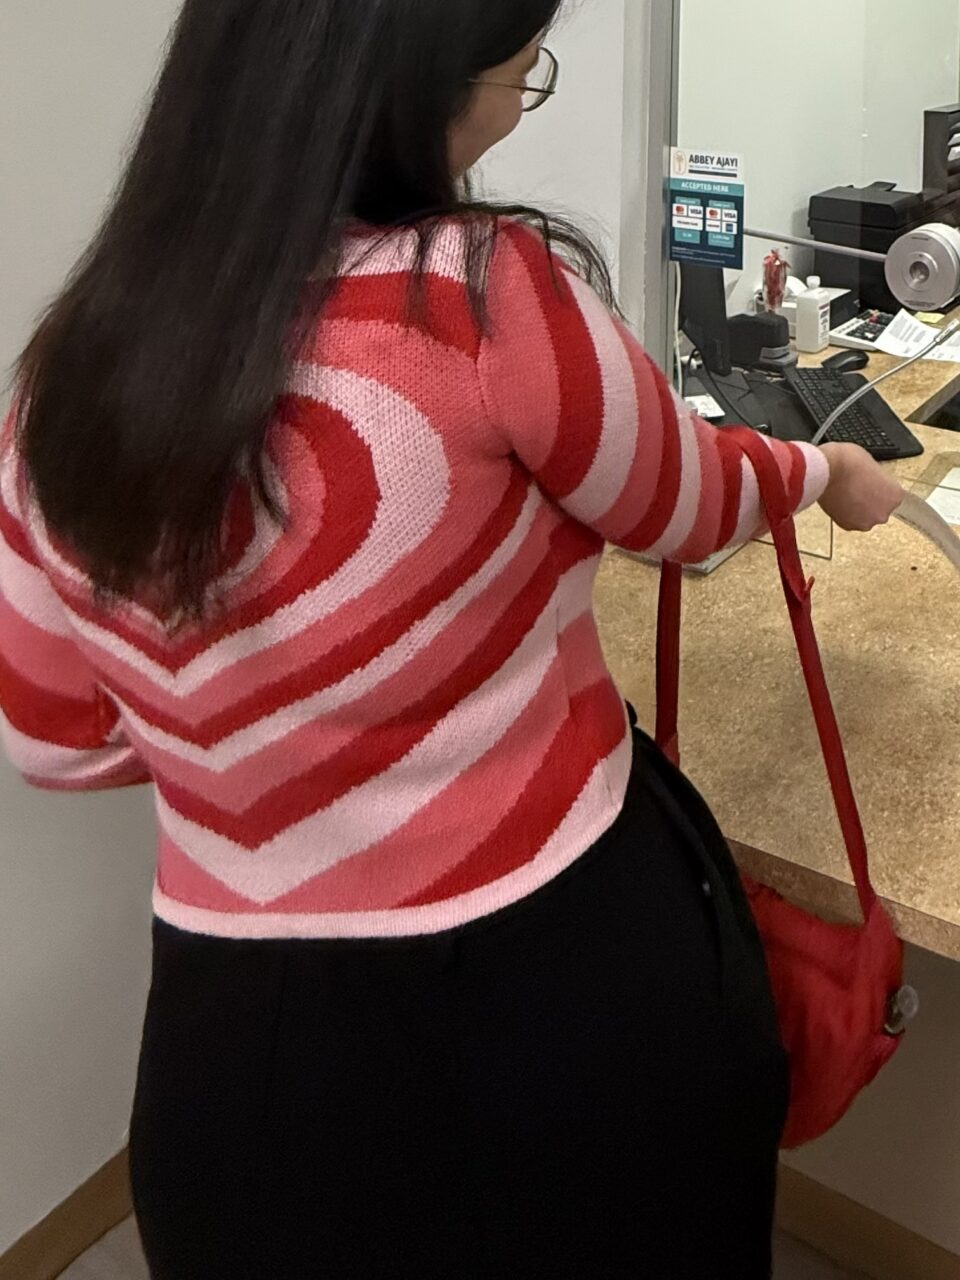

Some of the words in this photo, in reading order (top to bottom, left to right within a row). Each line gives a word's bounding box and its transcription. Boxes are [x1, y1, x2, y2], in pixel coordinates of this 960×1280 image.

[688, 153, 715, 166] ABBEY
[716, 156, 738, 168] AJAYI
[681, 181, 712, 191] ACCEPTED
[712, 184, 729, 193] HERE
